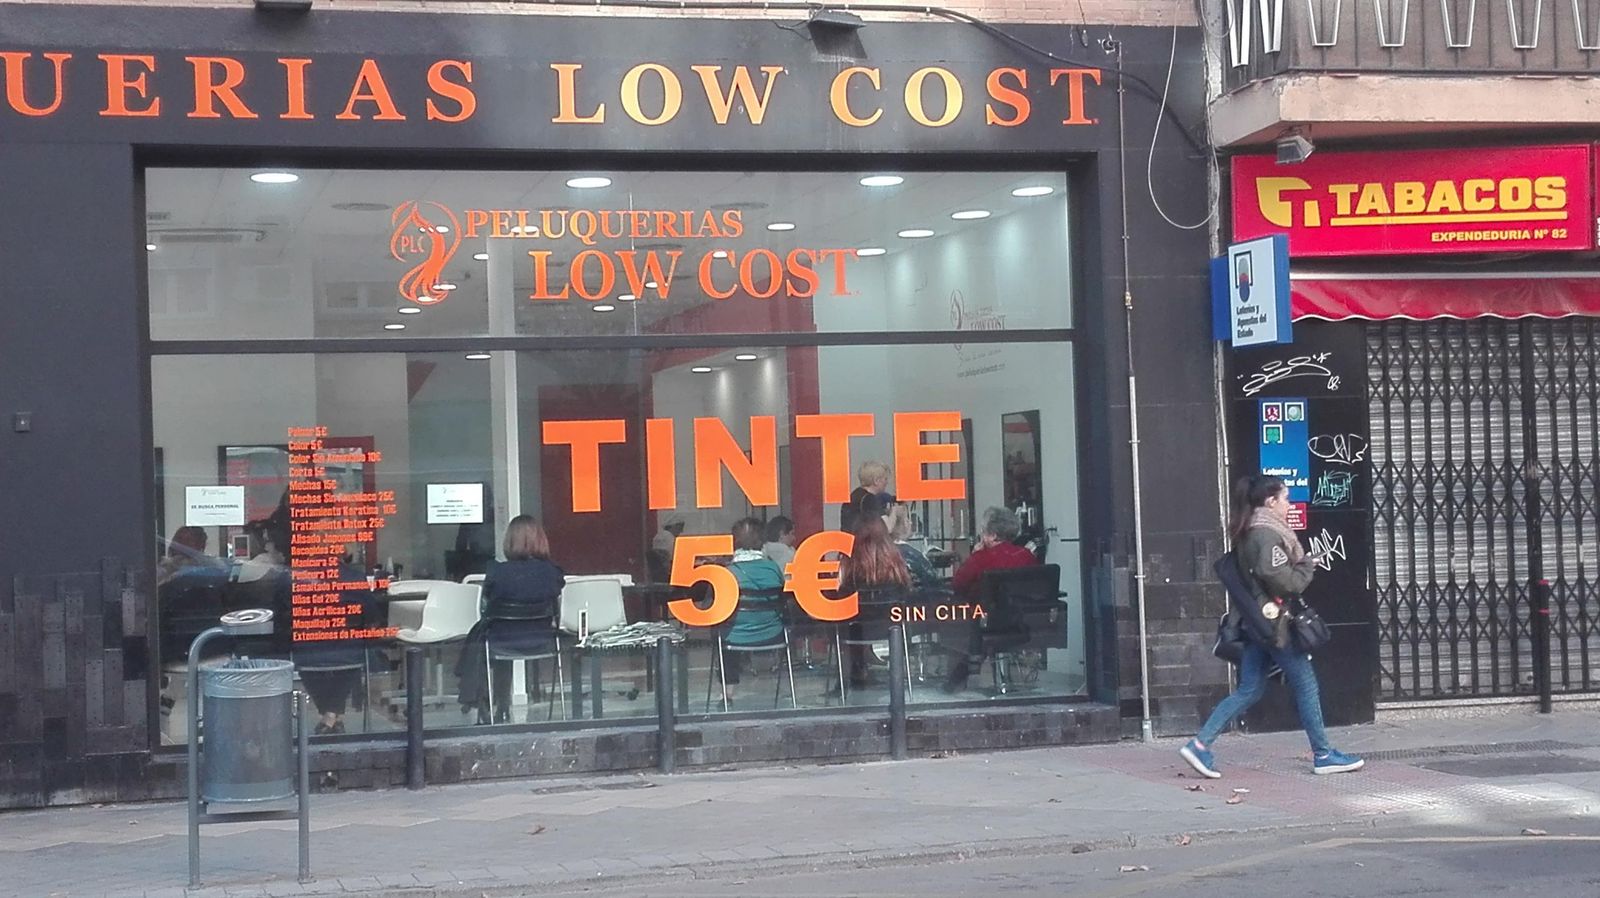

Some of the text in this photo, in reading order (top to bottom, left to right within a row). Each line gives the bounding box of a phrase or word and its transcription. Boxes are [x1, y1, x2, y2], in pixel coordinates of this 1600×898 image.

[0, 52, 1101, 127] UERIAS LOW COST
[1328, 176, 1567, 216] TABACOS
[464, 209, 744, 246] PELUQUERIAS
[1431, 230, 1530, 243] EXPENDEDURIA
[1552, 228, 1567, 240] 82
[401, 235, 425, 254] PLC
[528, 248, 860, 300] LOW COST
[288, 440, 310, 451] Color
[288, 454, 311, 464] Color
[542, 411, 966, 513] TINTE
[288, 466, 313, 477] Corte
[289, 480, 322, 491] Mechas
[289, 493, 322, 504] Mechas
[889, 603, 987, 623] SIN CITA
